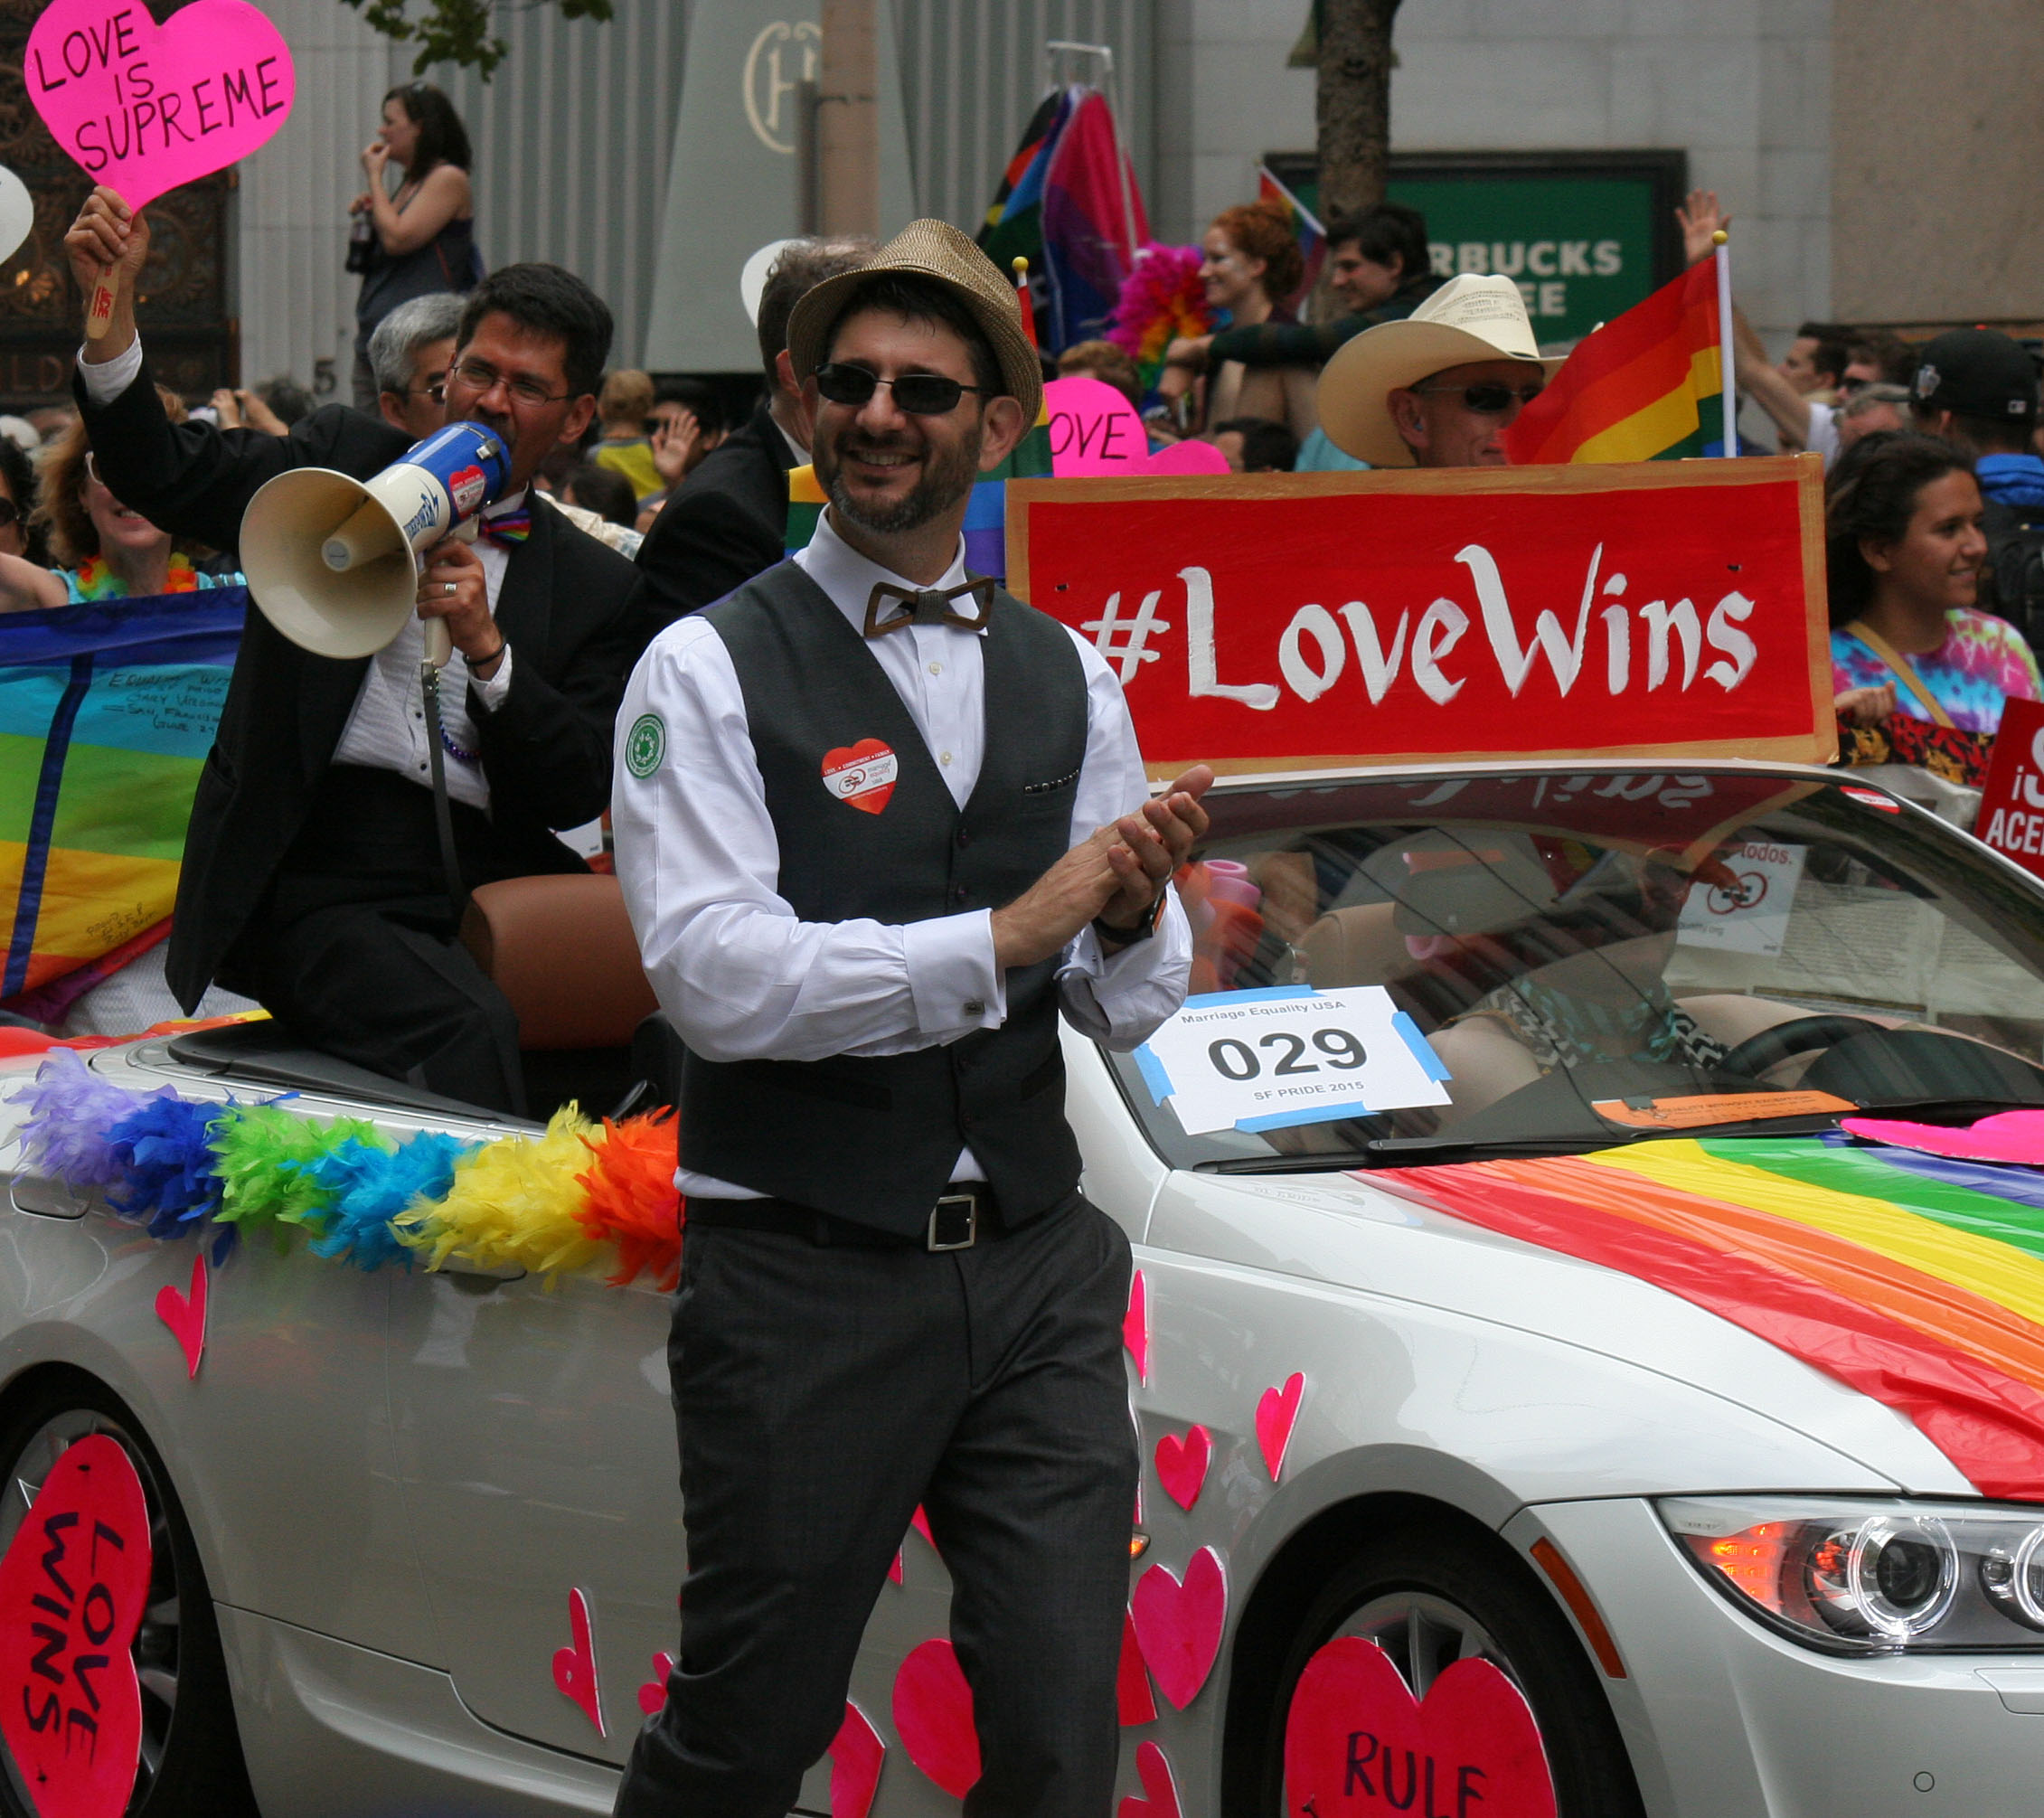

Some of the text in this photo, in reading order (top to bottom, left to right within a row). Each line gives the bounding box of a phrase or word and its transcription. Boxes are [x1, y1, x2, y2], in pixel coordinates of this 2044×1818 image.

[34, 9, 139, 92] LOVE
[114, 62, 154, 105] IS
[75, 56, 284, 172] SUPREME
[1050, 412, 1130, 459] OVE
[1080, 542, 1757, 711] #LoveWins
[1985, 808, 2044, 857] ACE
[1182, 1000, 1346, 1024] Marriage Equality USA
[1207, 1028, 1368, 1081] 029
[1253, 1080, 1364, 1101] SF PRIDE 2015
[23, 1512, 79, 1734] WINS
[66, 1520, 124, 1766] LOVE
